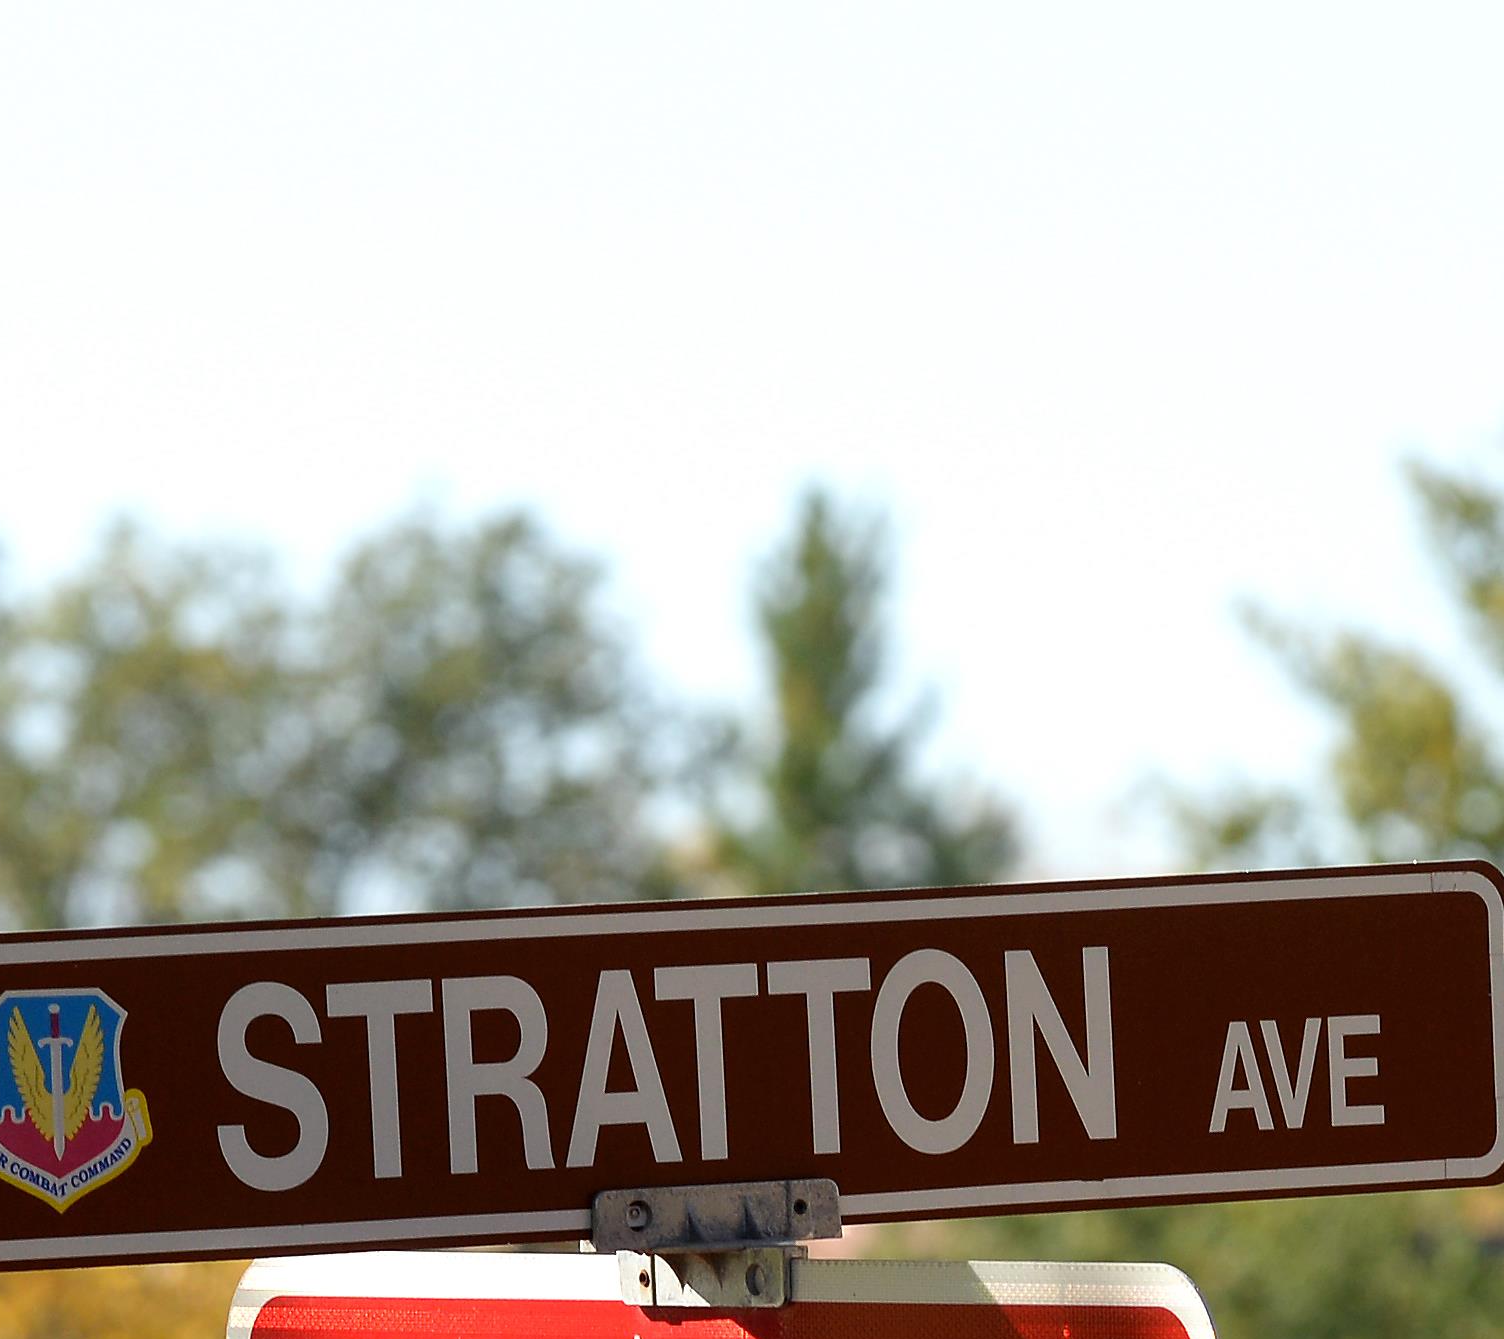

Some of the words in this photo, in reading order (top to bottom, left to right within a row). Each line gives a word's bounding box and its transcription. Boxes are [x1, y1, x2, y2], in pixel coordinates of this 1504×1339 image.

[216, 945, 1119, 1193] STRATTON
[1208, 1014, 1386, 1134] AVE
[10, 1162, 68, 1197] COMBAT
[70, 1137, 132, 1188] COMMAND
